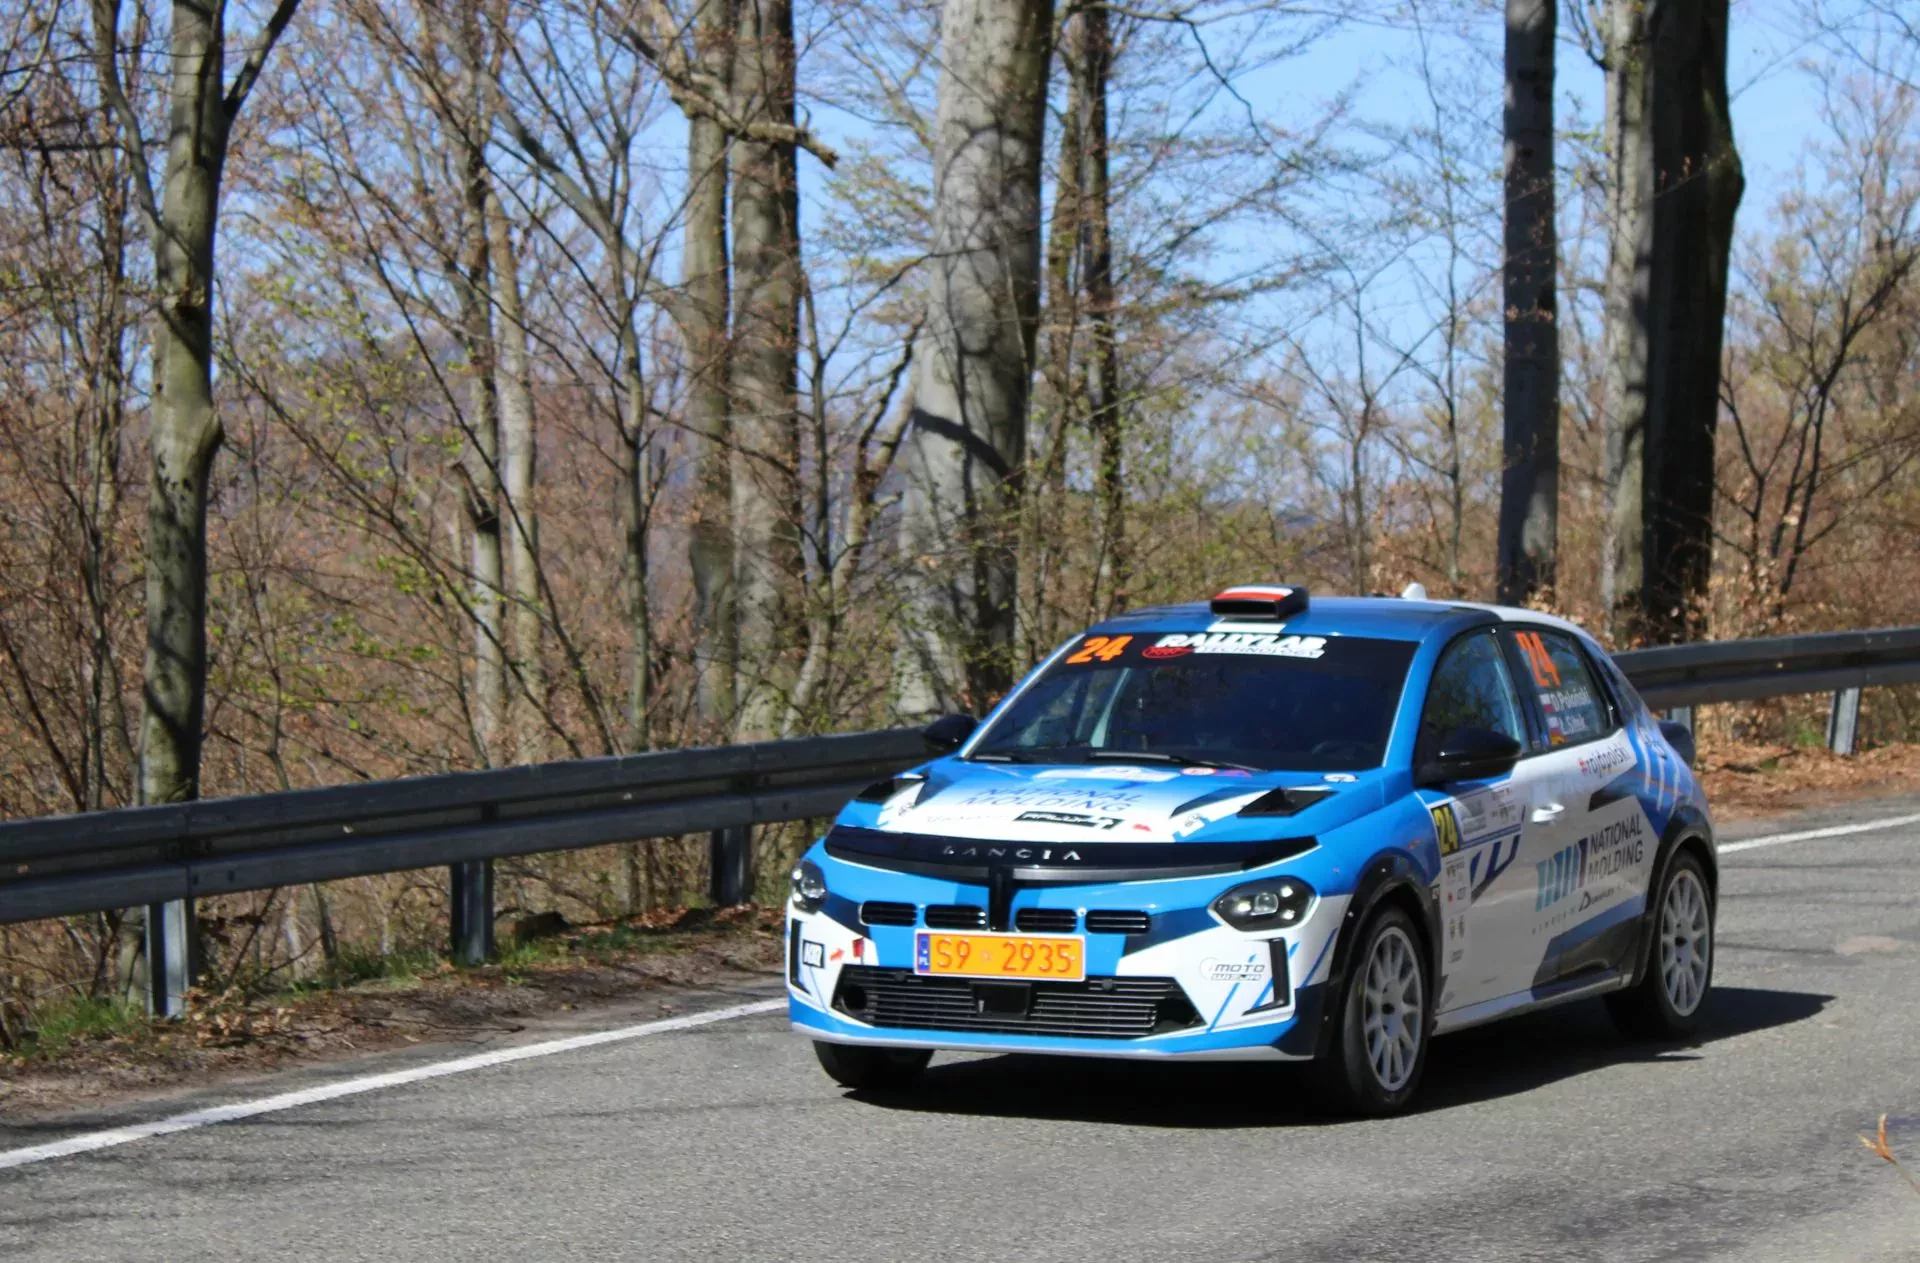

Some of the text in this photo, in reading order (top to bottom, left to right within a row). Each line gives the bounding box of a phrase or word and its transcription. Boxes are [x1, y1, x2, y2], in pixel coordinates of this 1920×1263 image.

[1066, 635, 1134, 664] 24
[1515, 631, 1561, 687] 24
[1432, 806, 1459, 855] 24
[1589, 814, 1643, 856] NATIONAL
[942, 845, 1082, 861] LANCIA
[1587, 840, 1644, 882] MOLDING
[935, 937, 1076, 975] S9 2935
